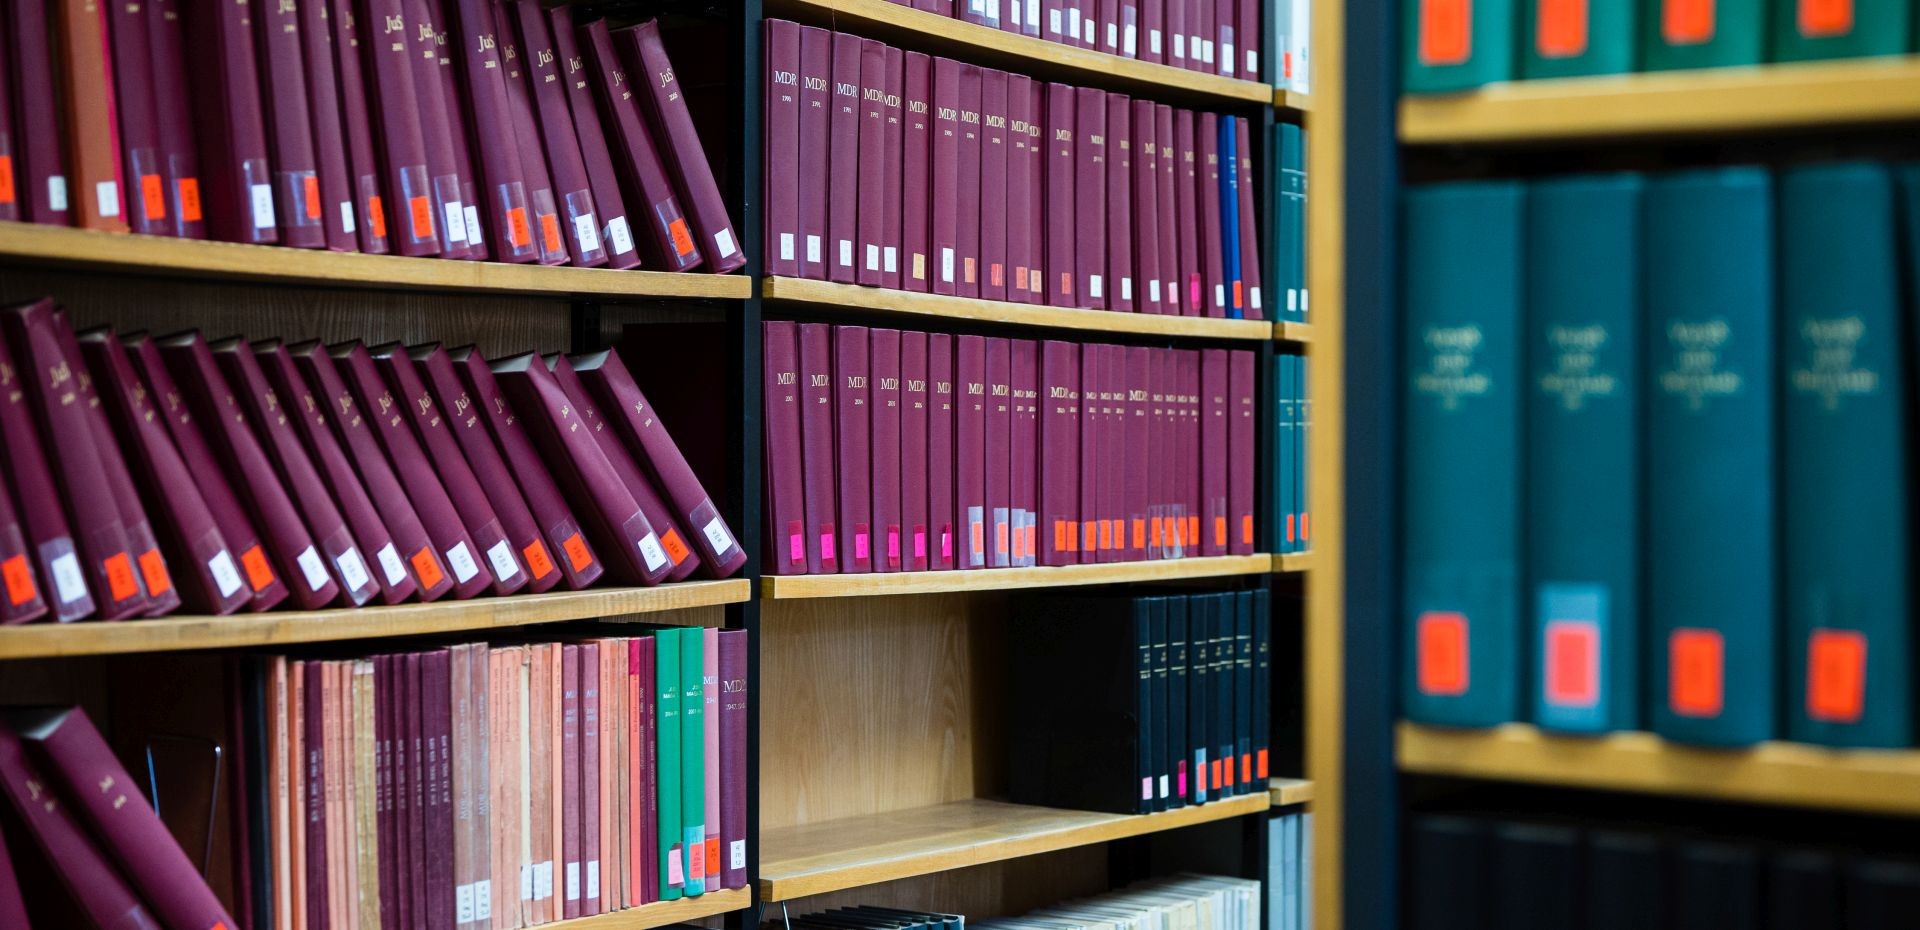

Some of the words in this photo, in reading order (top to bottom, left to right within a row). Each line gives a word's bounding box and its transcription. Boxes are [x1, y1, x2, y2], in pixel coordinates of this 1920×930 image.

[384, 14, 404, 34] JuS
[418, 23, 434, 42] JuS
[478, 33, 495, 53] JuS
[503, 45, 516, 62] JuS
[537, 48, 554, 67] JuS
[659, 67, 674, 88] JuS
[775, 71, 798, 86] MDR
[805, 77, 827, 92] MDR
[837, 83, 858, 98] MDR
[864, 88, 884, 104] MDR
[909, 100, 928, 115] MDR
[938, 107, 958, 122] MDR
[961, 110, 980, 125] MDR
[985, 115, 1006, 129] MDR
[1011, 120, 1029, 133] MDR
[777, 372, 796, 385] MDR
[848, 376, 868, 389] MDR
[881, 378, 899, 390] MDR
[908, 380, 925, 392] MDR
[455, 391, 470, 416] JuS
